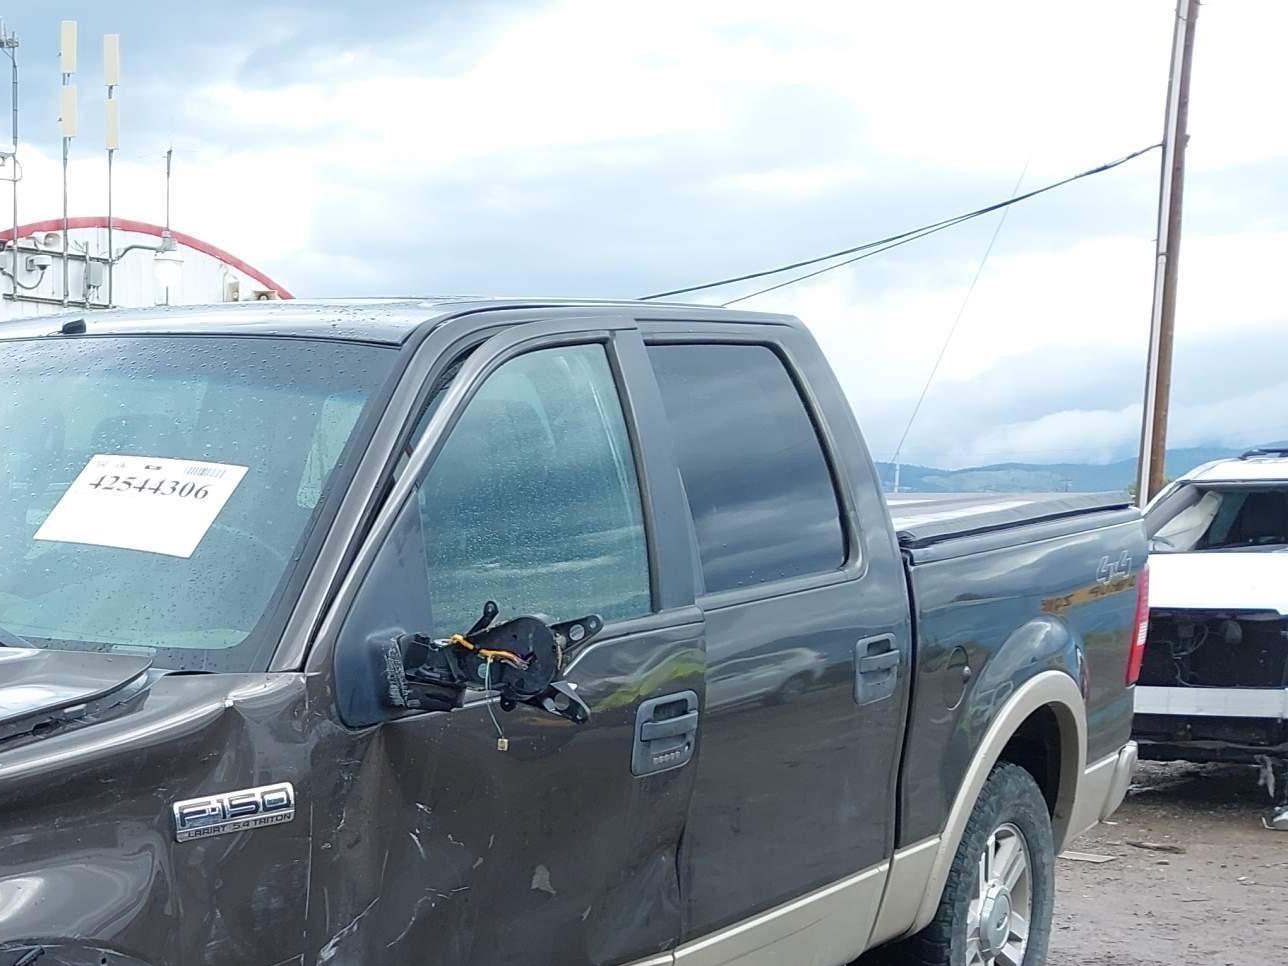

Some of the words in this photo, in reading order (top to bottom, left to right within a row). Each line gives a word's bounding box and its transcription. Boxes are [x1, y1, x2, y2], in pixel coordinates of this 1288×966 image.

[89, 473, 213, 500] 42544306
[179, 787, 292, 828] F-150
[253, 813, 291, 827] TRITON
